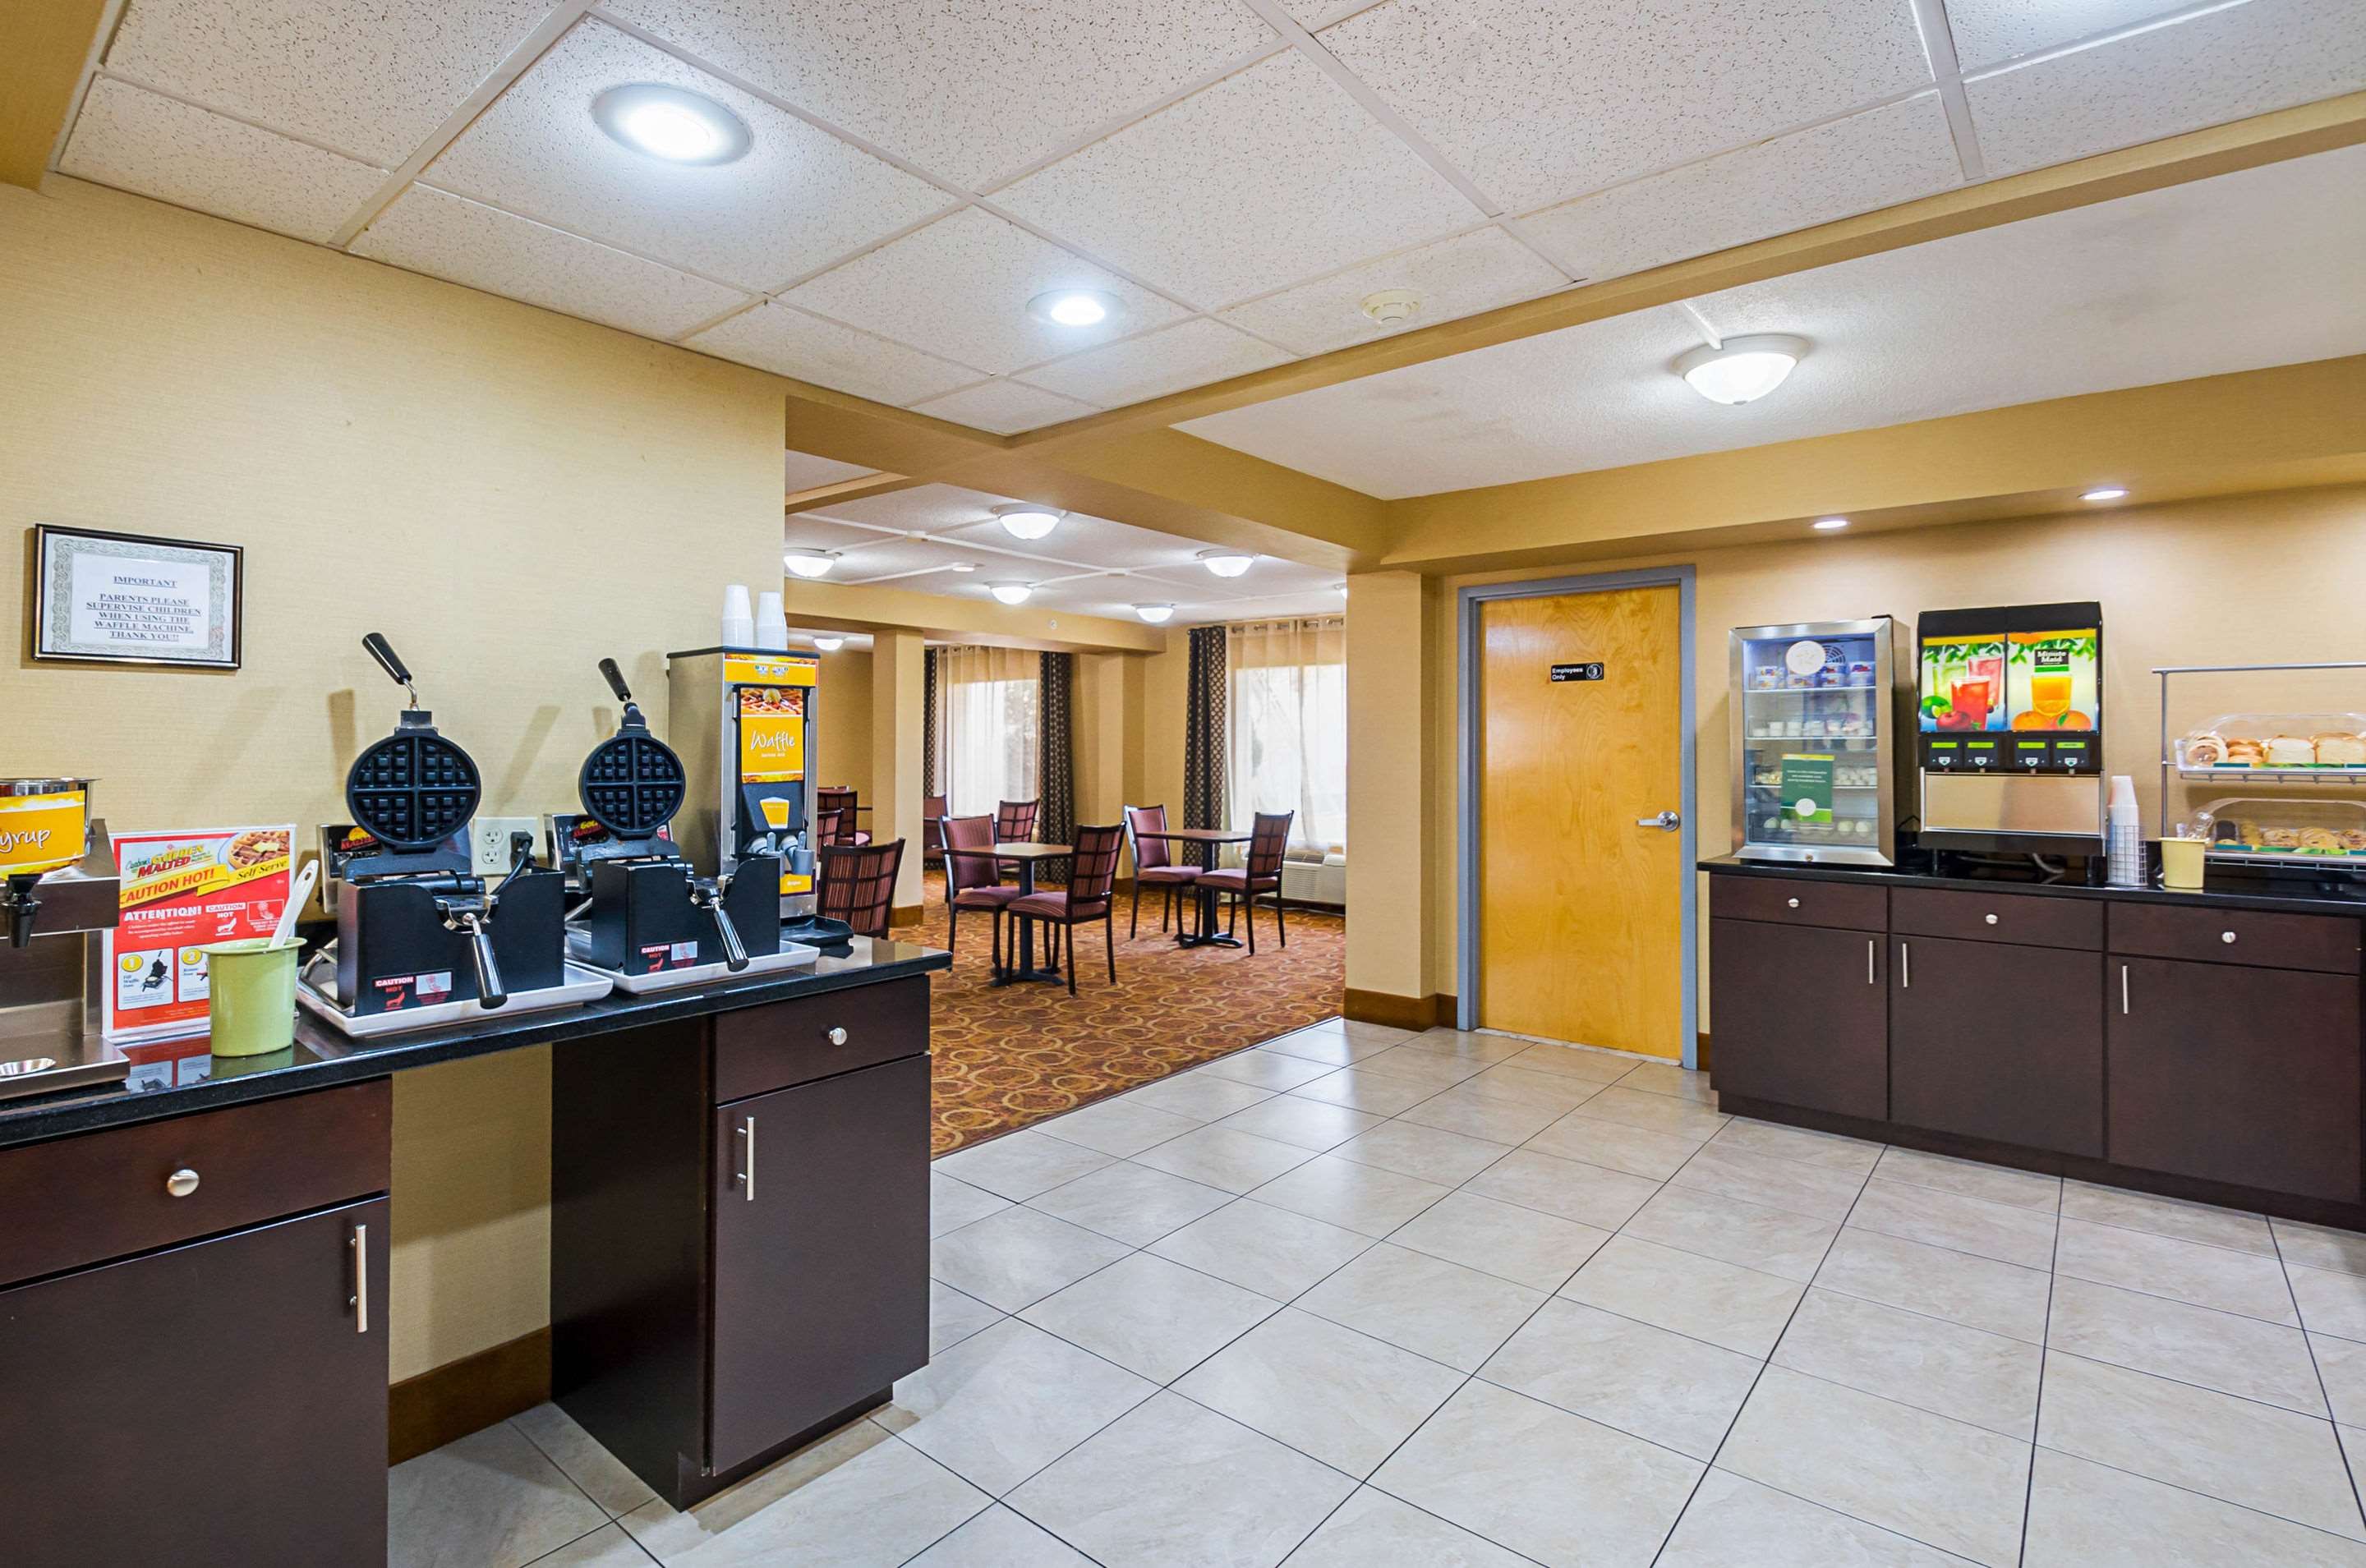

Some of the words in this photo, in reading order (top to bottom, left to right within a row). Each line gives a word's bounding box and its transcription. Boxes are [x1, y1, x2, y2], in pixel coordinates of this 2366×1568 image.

[113, 576, 177, 588] IMPORTANT
[99, 593, 149, 604] PARENTS
[151, 597, 190, 607] PLEASE
[86, 602, 145, 612] SUPERVISE
[148, 605, 201, 617] CHILDREN
[99, 612, 132, 621] WHEN
[135, 614, 167, 623] USING
[170, 616, 190, 625] THE
[94, 621, 140, 631] WAFFLE
[109, 631, 147, 641] THANK
[750, 729, 796, 751] Waffle
[0, 827, 52, 853] yrup
[137, 856, 191, 878] MALTED
[237, 867, 257, 881] Self
[182, 868, 214, 888] HOT!
[124, 905, 202, 922] ATTENTION!
[208, 904, 244, 912] CAUTION
[641, 945, 670, 954] CAUTION
[375, 976, 414, 987] CAUTION
